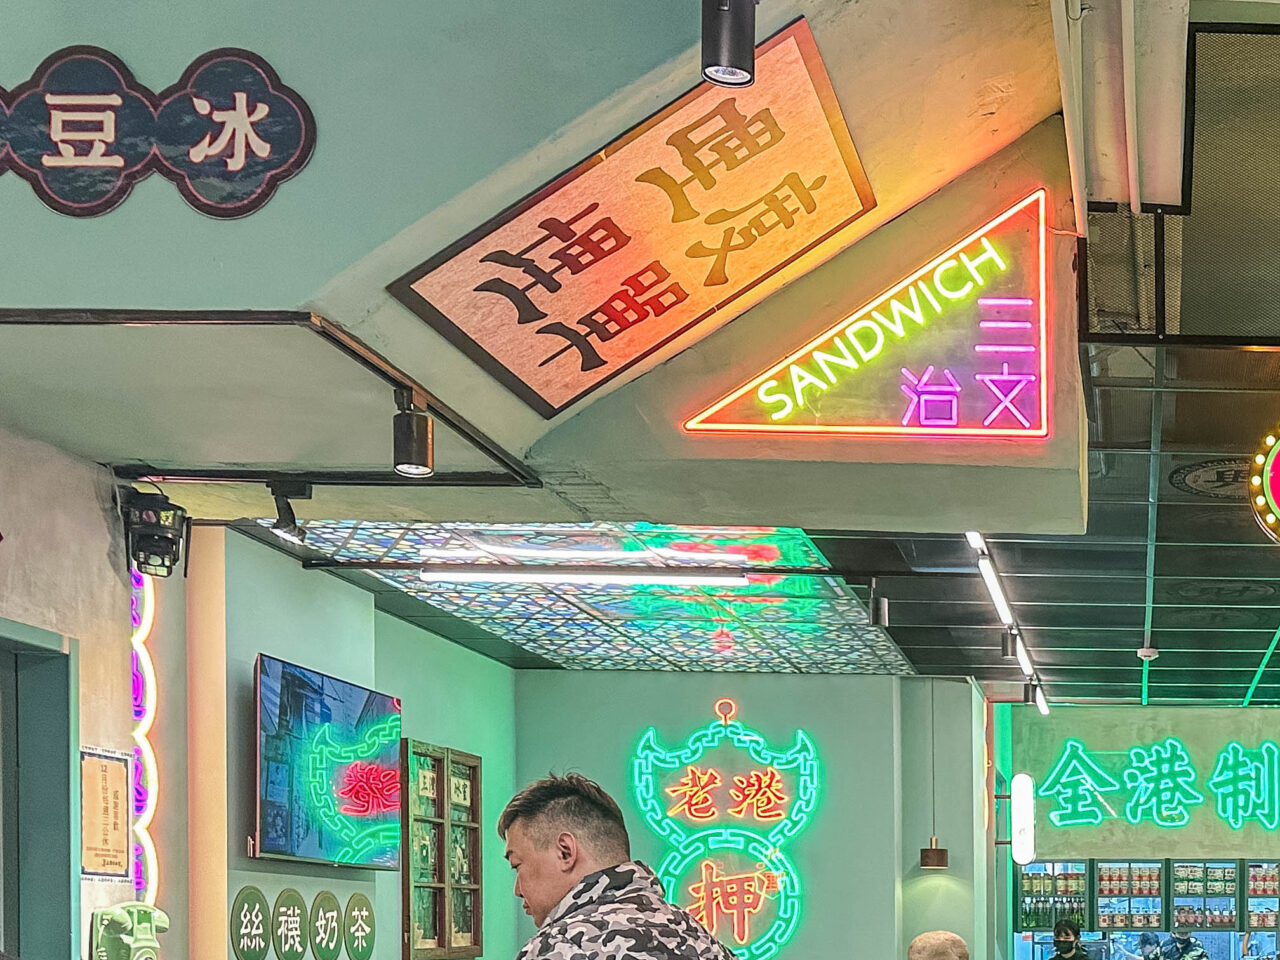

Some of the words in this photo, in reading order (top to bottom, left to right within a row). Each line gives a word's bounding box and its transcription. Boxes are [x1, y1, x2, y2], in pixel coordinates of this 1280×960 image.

[42, 92, 271, 170] 豆冰
[756, 235, 1009, 422] SANDWICH
[665, 763, 789, 822] 老港
[240, 903, 371, 953] 絲襪奶茶
[687, 860, 767, 945] 押
